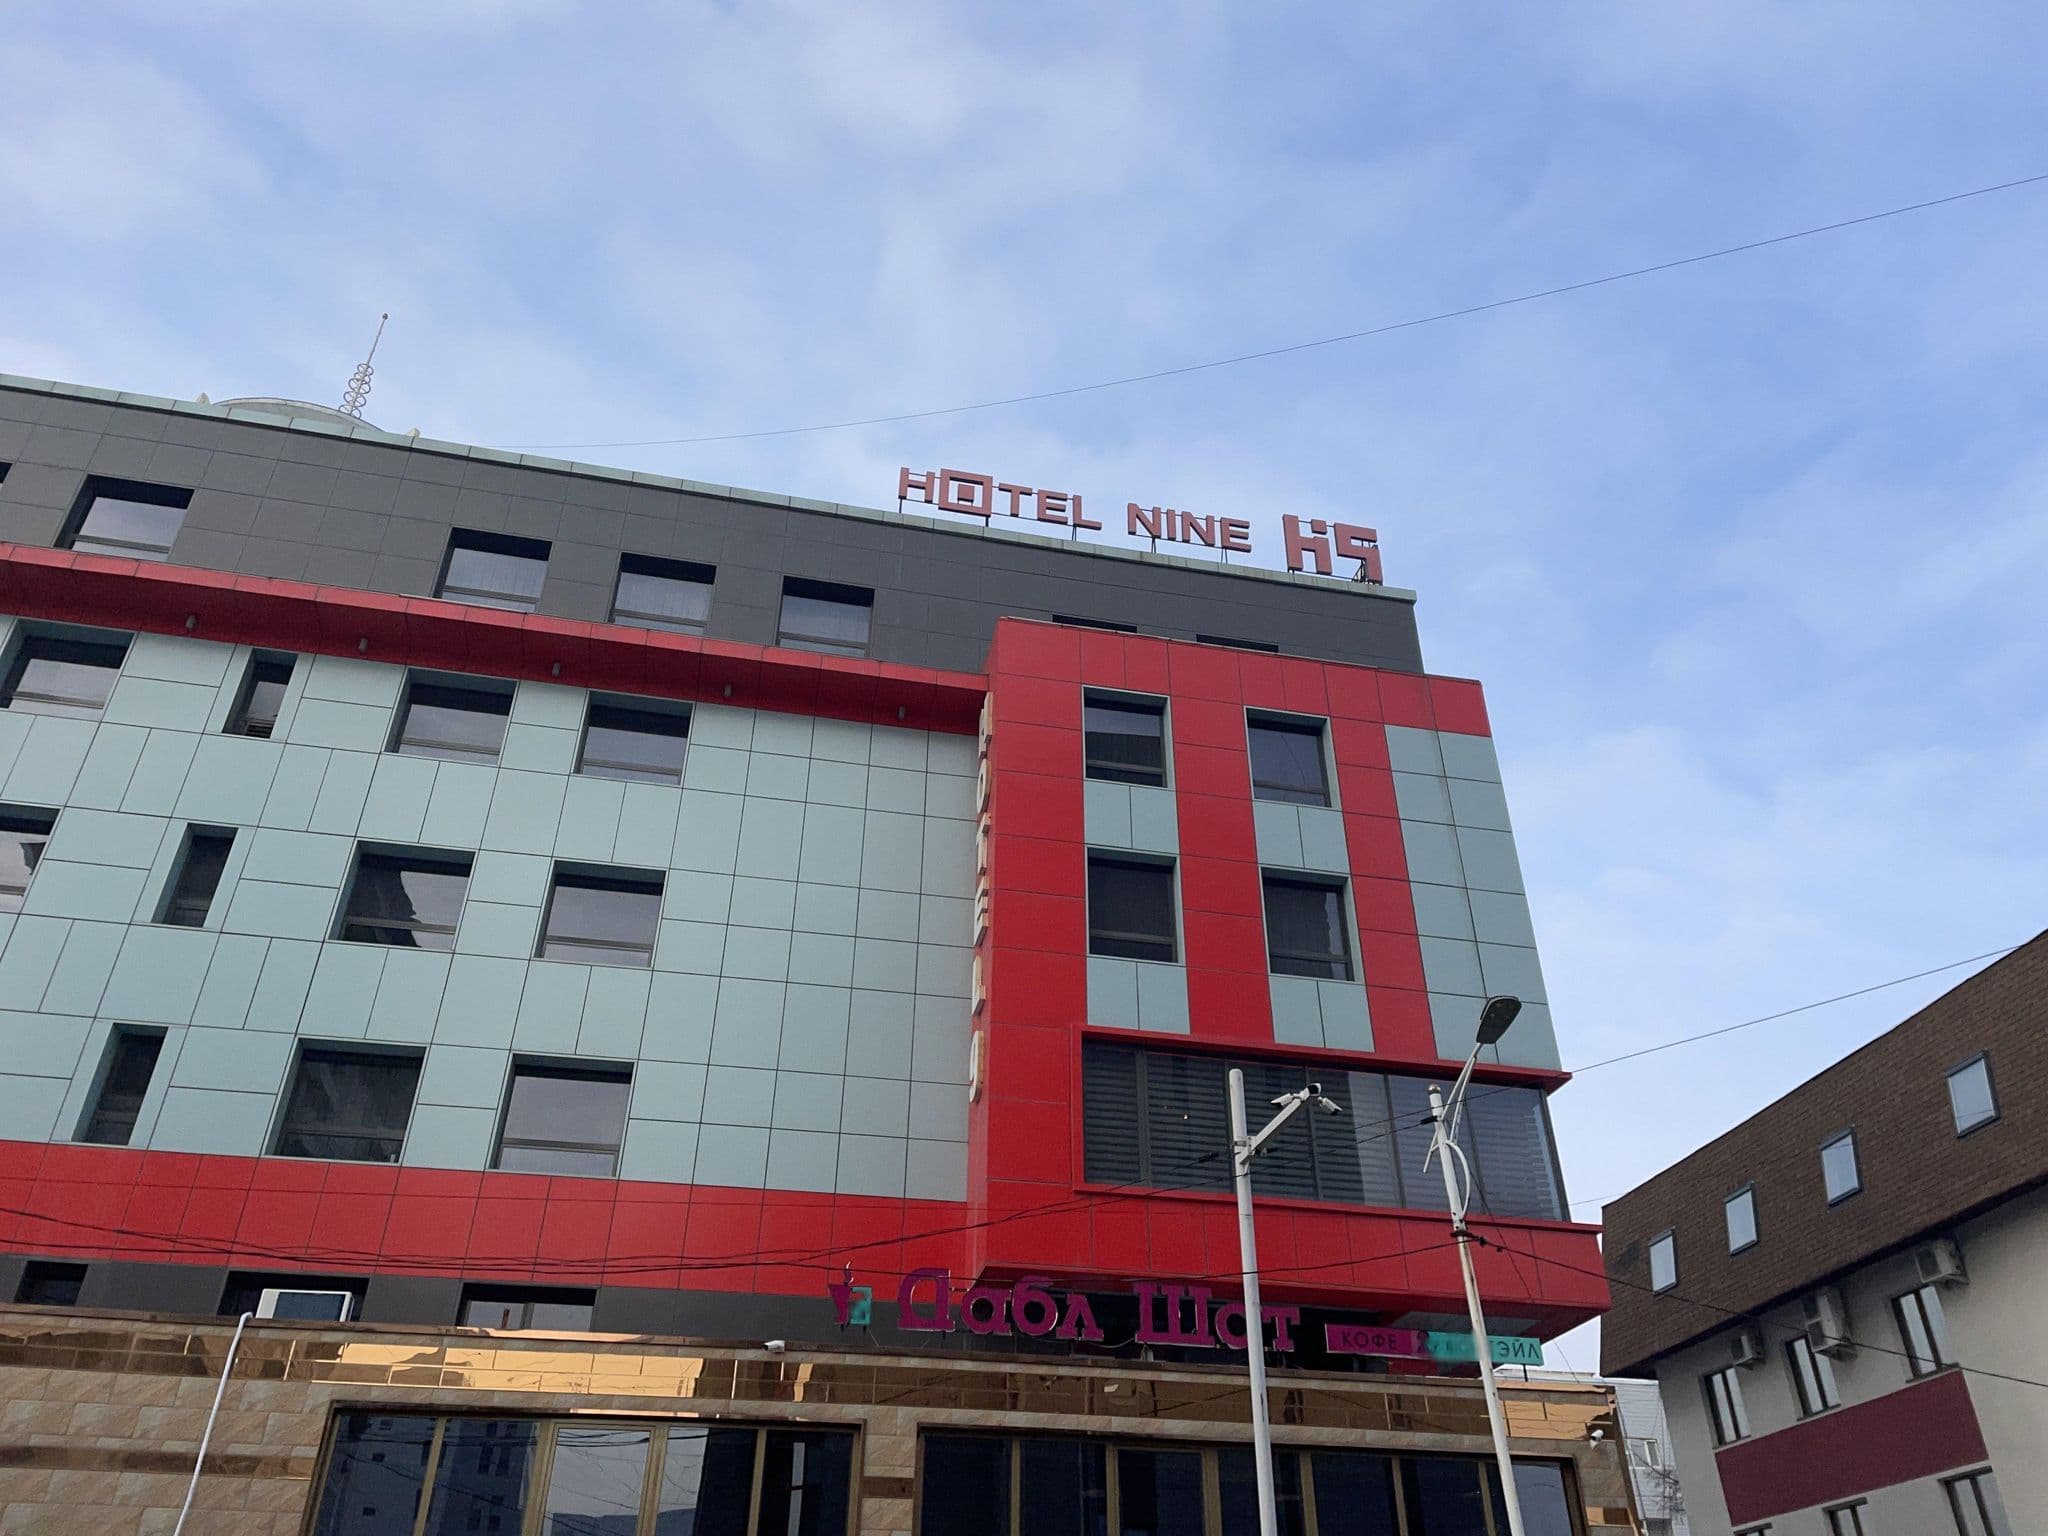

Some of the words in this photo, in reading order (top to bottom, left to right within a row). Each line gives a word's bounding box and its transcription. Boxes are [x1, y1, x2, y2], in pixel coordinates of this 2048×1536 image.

[898, 467, 1102, 531] HOTEL
[1127, 503, 1252, 553] NINE
[1134, 1281, 1300, 1352] Шот
[1341, 1331, 1397, 1350] КОФЕ
